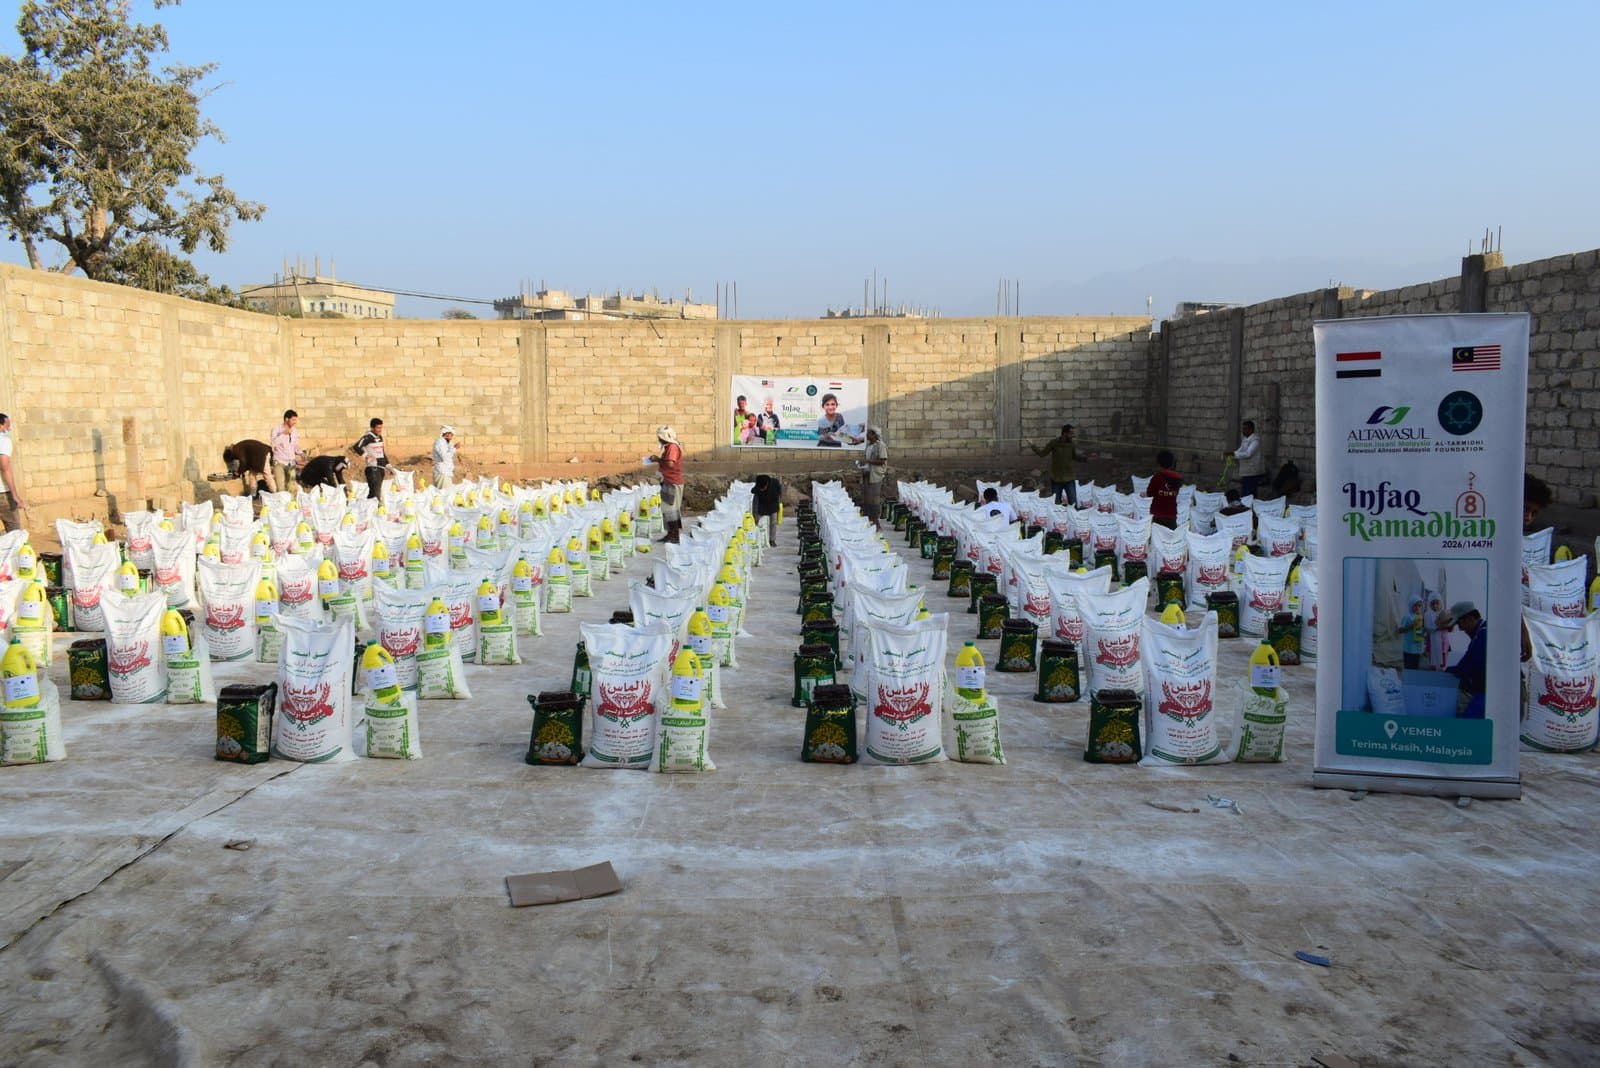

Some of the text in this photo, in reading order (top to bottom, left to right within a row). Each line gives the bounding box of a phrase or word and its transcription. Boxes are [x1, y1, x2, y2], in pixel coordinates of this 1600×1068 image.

[1347, 428, 1430, 440] ALTAWASUL
[1342, 481, 1428, 516] Infaq
[1464, 495, 1477, 514] 8
[1342, 512, 1496, 542] Ramadhan
[1442, 540, 1493, 549] 2026/1447H
[288, 682, 323, 696] الماس
[607, 680, 644, 694] الماس
[886, 682, 922, 698] الماس
[1171, 679, 1206, 695] الماس
[1402, 726, 1442, 737] YEMEN
[1351, 739, 1473, 758] Terima Kasih, Malaysia
